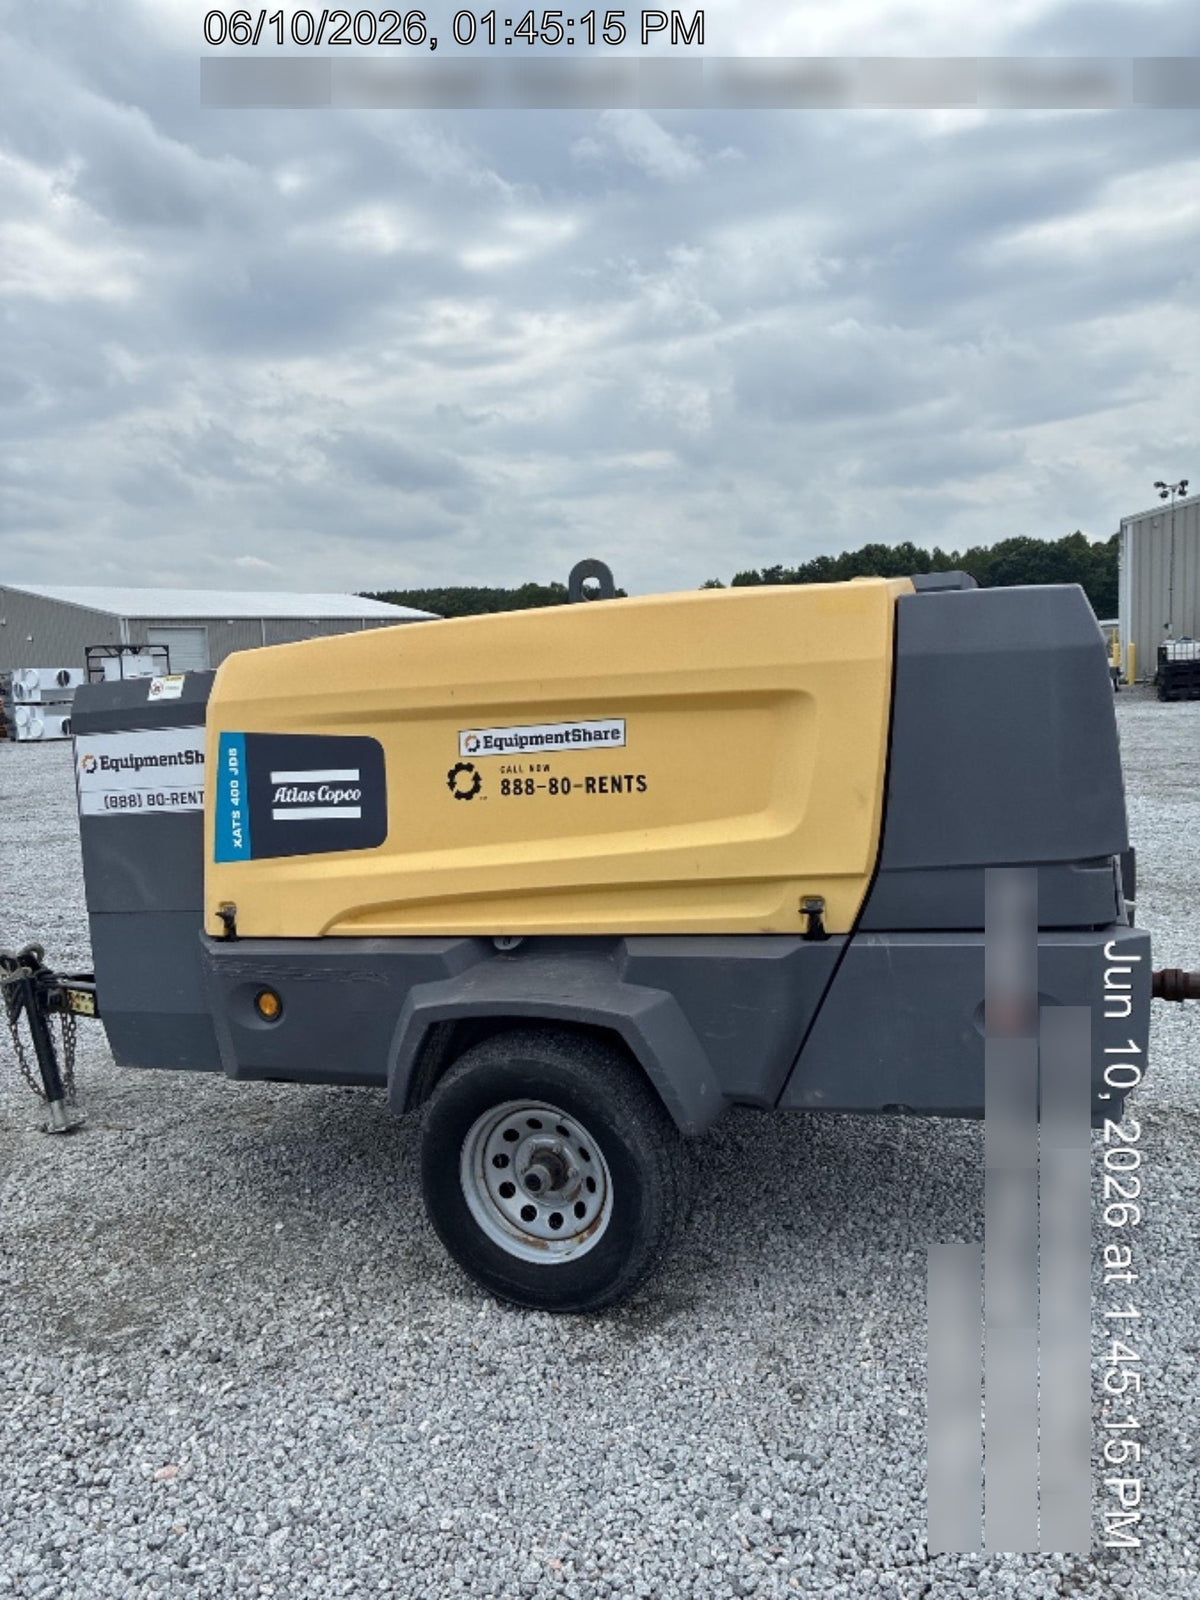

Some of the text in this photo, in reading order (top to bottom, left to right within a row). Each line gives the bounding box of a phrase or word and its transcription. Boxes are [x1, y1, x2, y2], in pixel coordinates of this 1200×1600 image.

[482, 728, 622, 750] EquipmentShare
[500, 763, 551, 775] CALL NOW
[229, 779, 240, 807] 400
[272, 785, 362, 804] Atlas Copco
[500, 774, 648, 796] 888-80-RENTS
[103, 792, 143, 810] (888)
[231, 810, 243, 849] XATS
